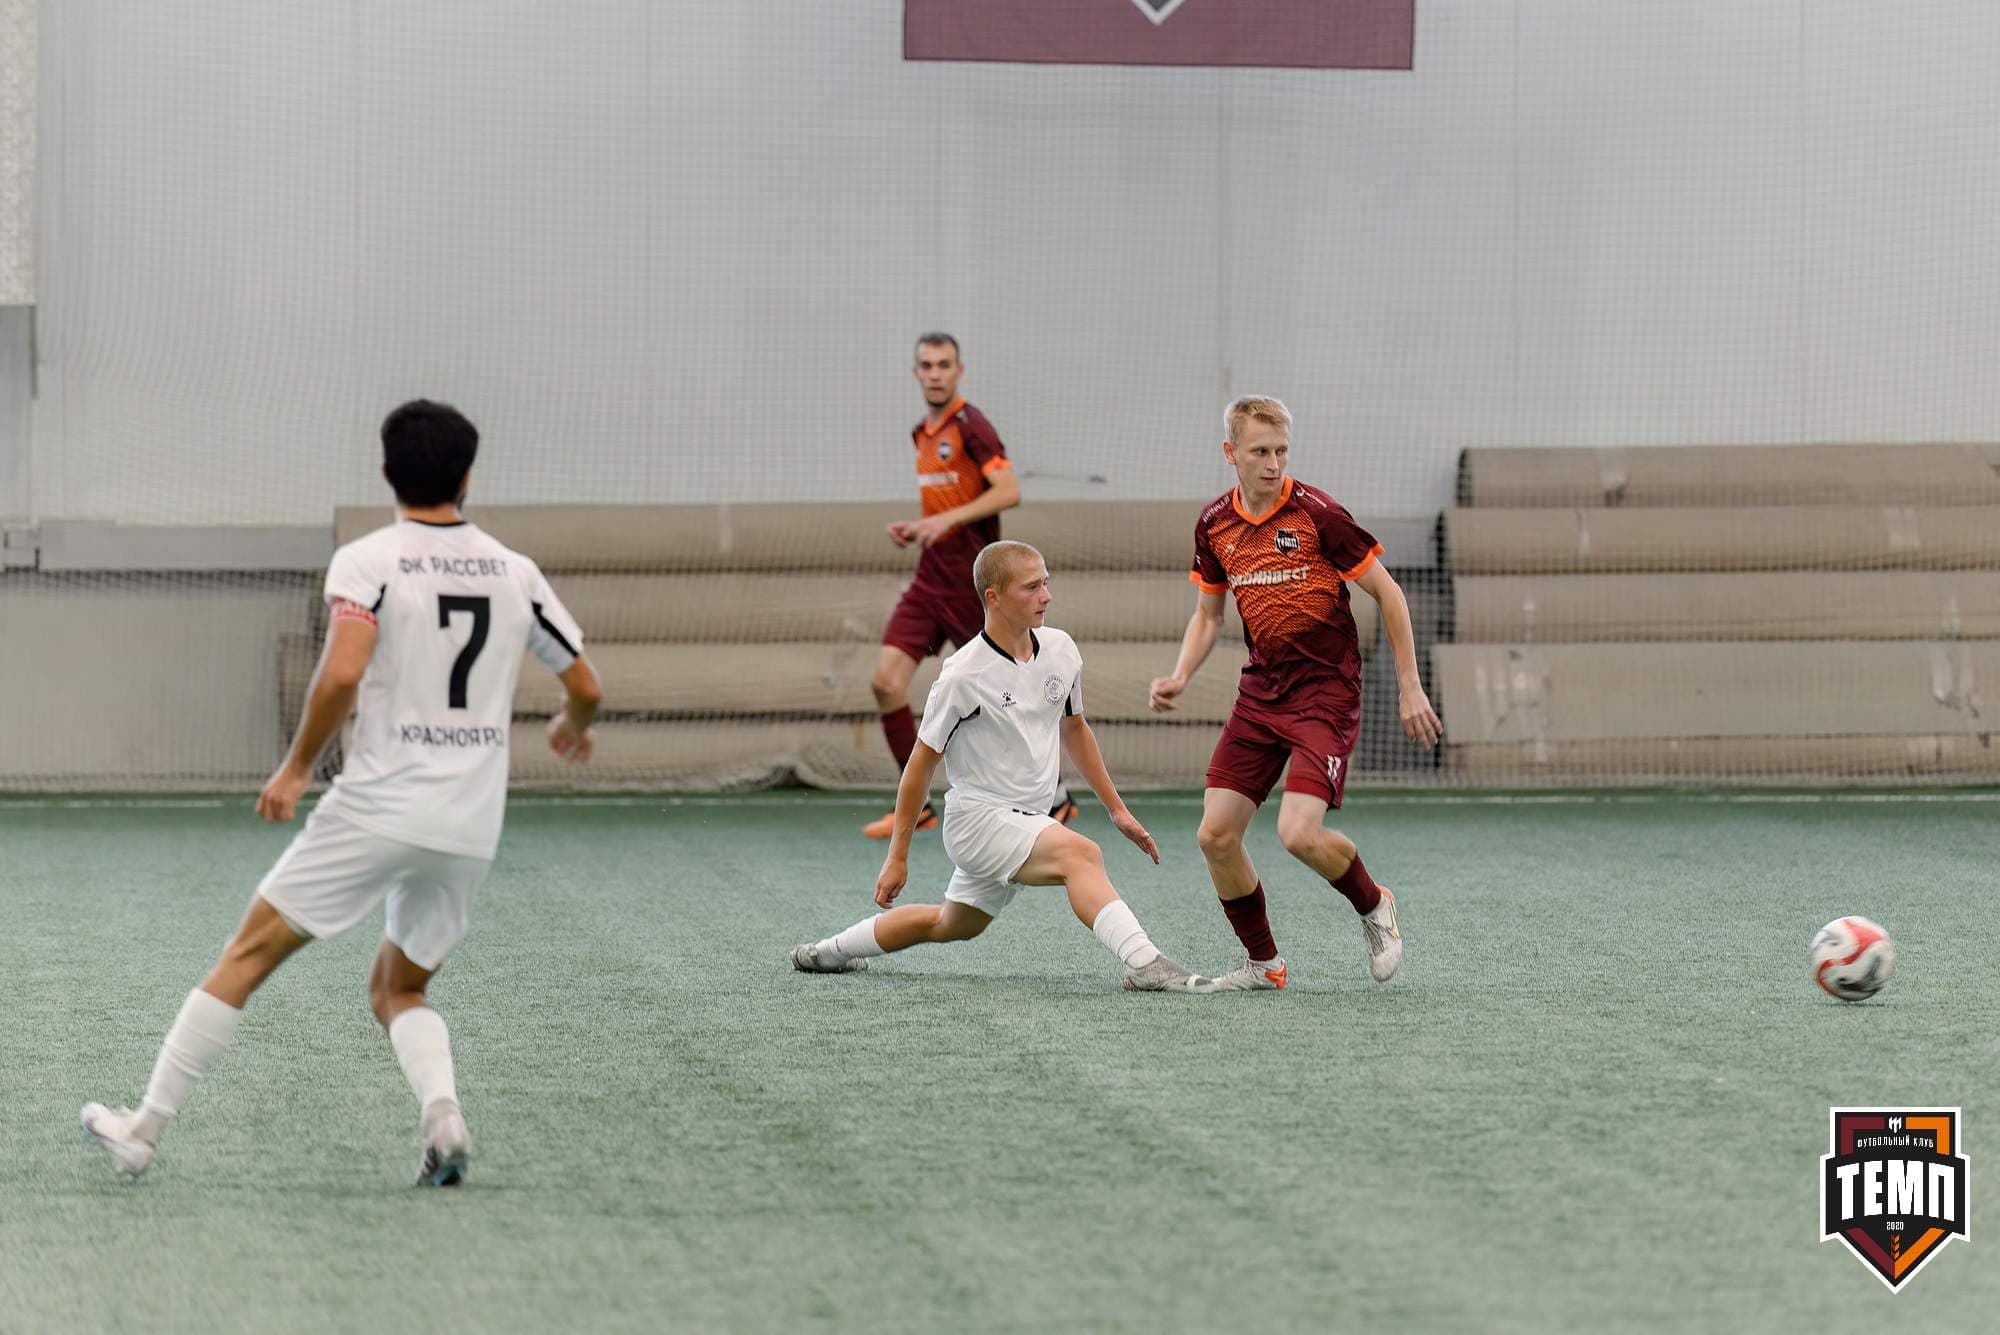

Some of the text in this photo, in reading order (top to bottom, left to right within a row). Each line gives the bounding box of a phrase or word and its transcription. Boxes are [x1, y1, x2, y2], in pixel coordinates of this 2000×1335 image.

[399, 556, 508, 576] ФК РАССВЕТ
[438, 594, 490, 709] 7
